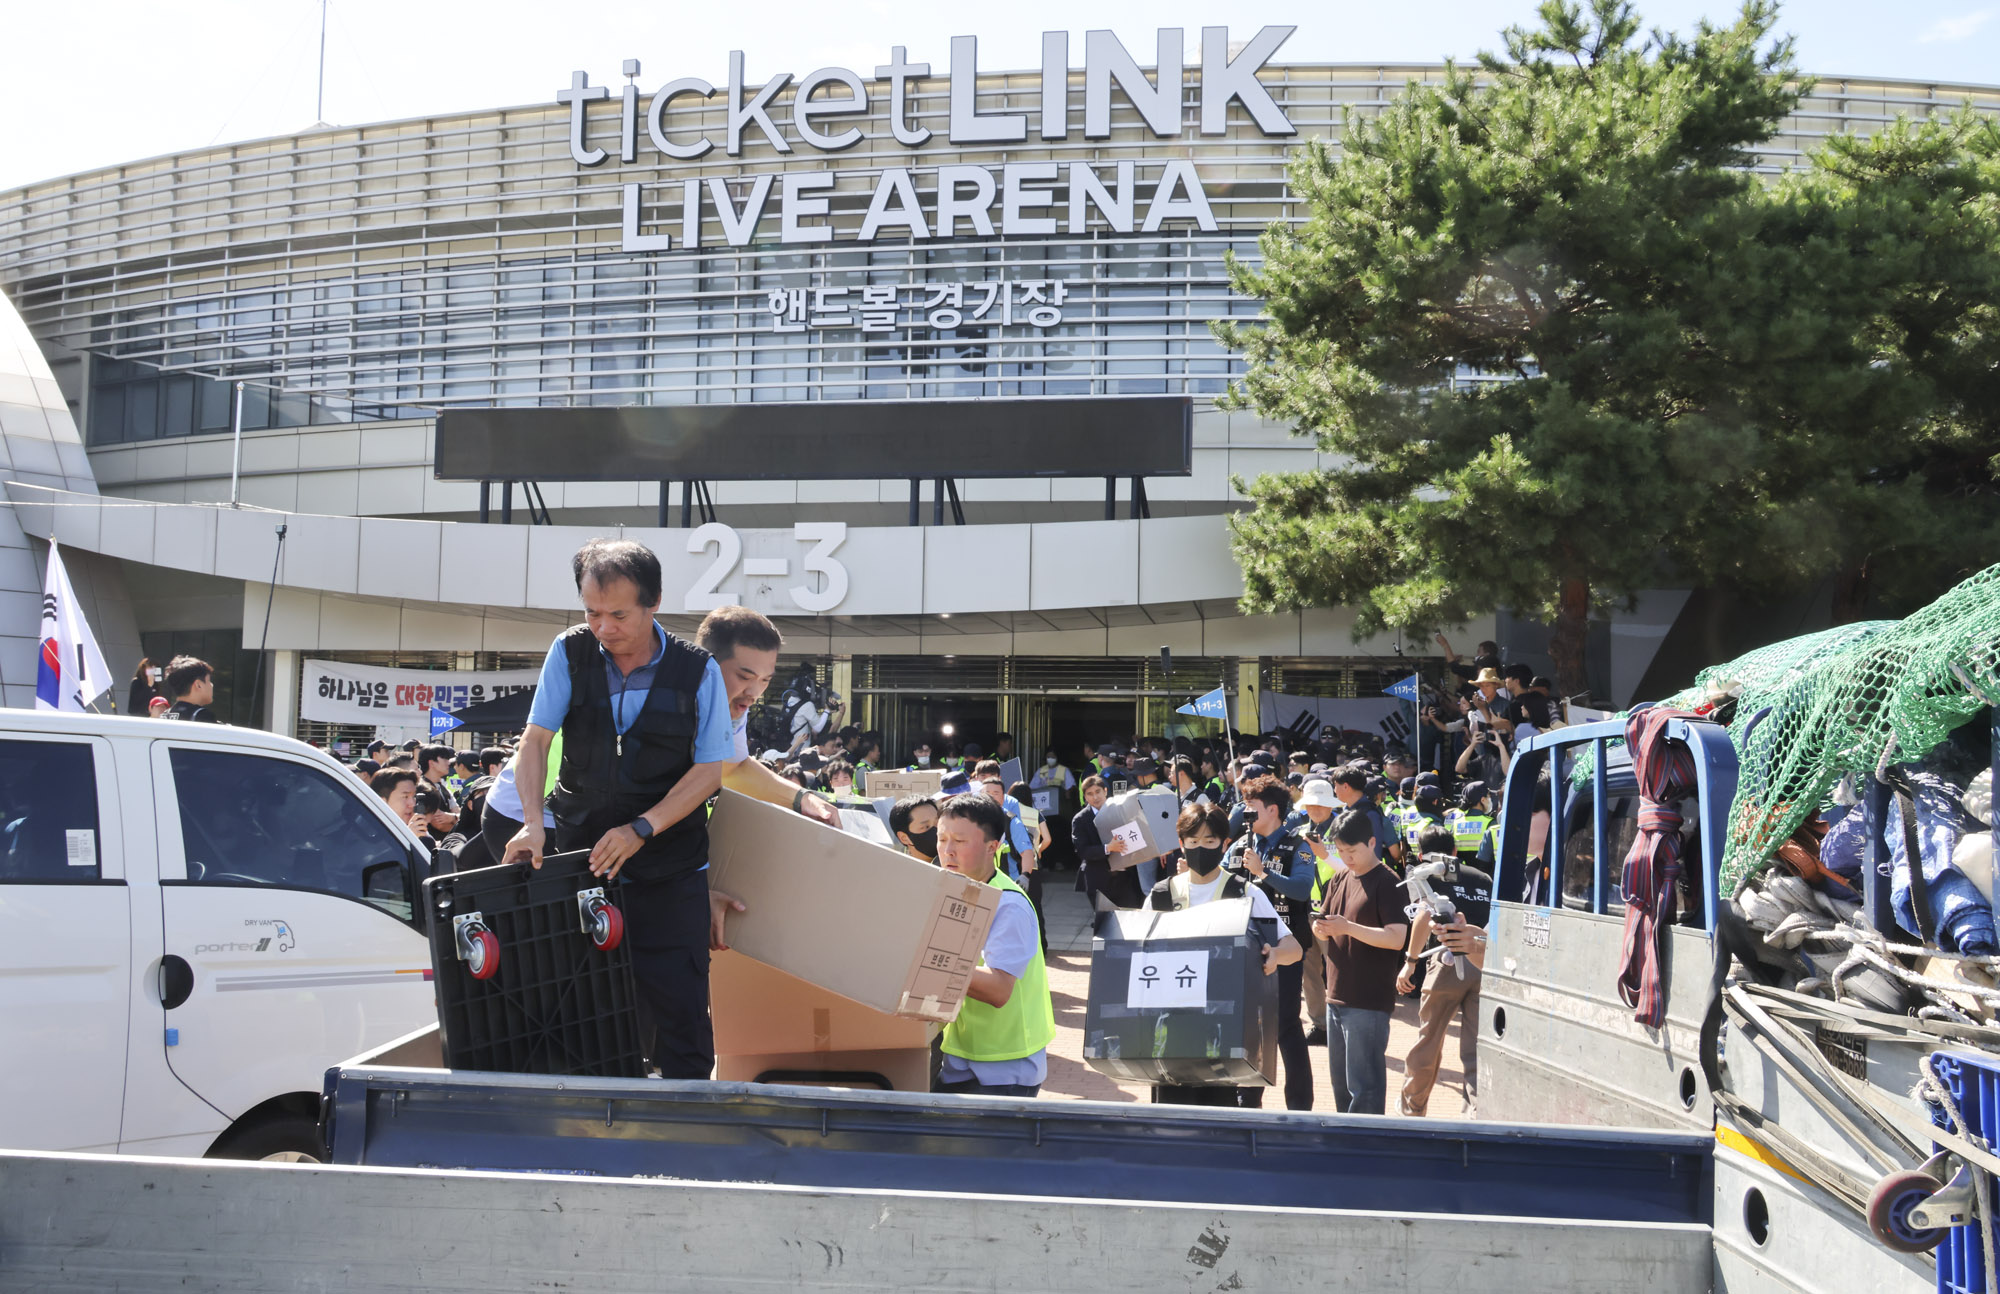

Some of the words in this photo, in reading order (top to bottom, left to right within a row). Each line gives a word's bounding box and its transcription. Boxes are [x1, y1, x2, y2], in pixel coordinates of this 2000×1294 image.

[557, 25, 1299, 166] ticketLINK
[621, 170, 836, 253] LIVE
[857, 159, 1219, 241] ARENA
[768, 286, 901, 333] 핸드볼
[923, 279, 1068, 330] 경기장
[684, 521, 848, 612] 2-3
[318, 675, 390, 709] 하나님은
[1456, 892, 1490, 902] POLICE
